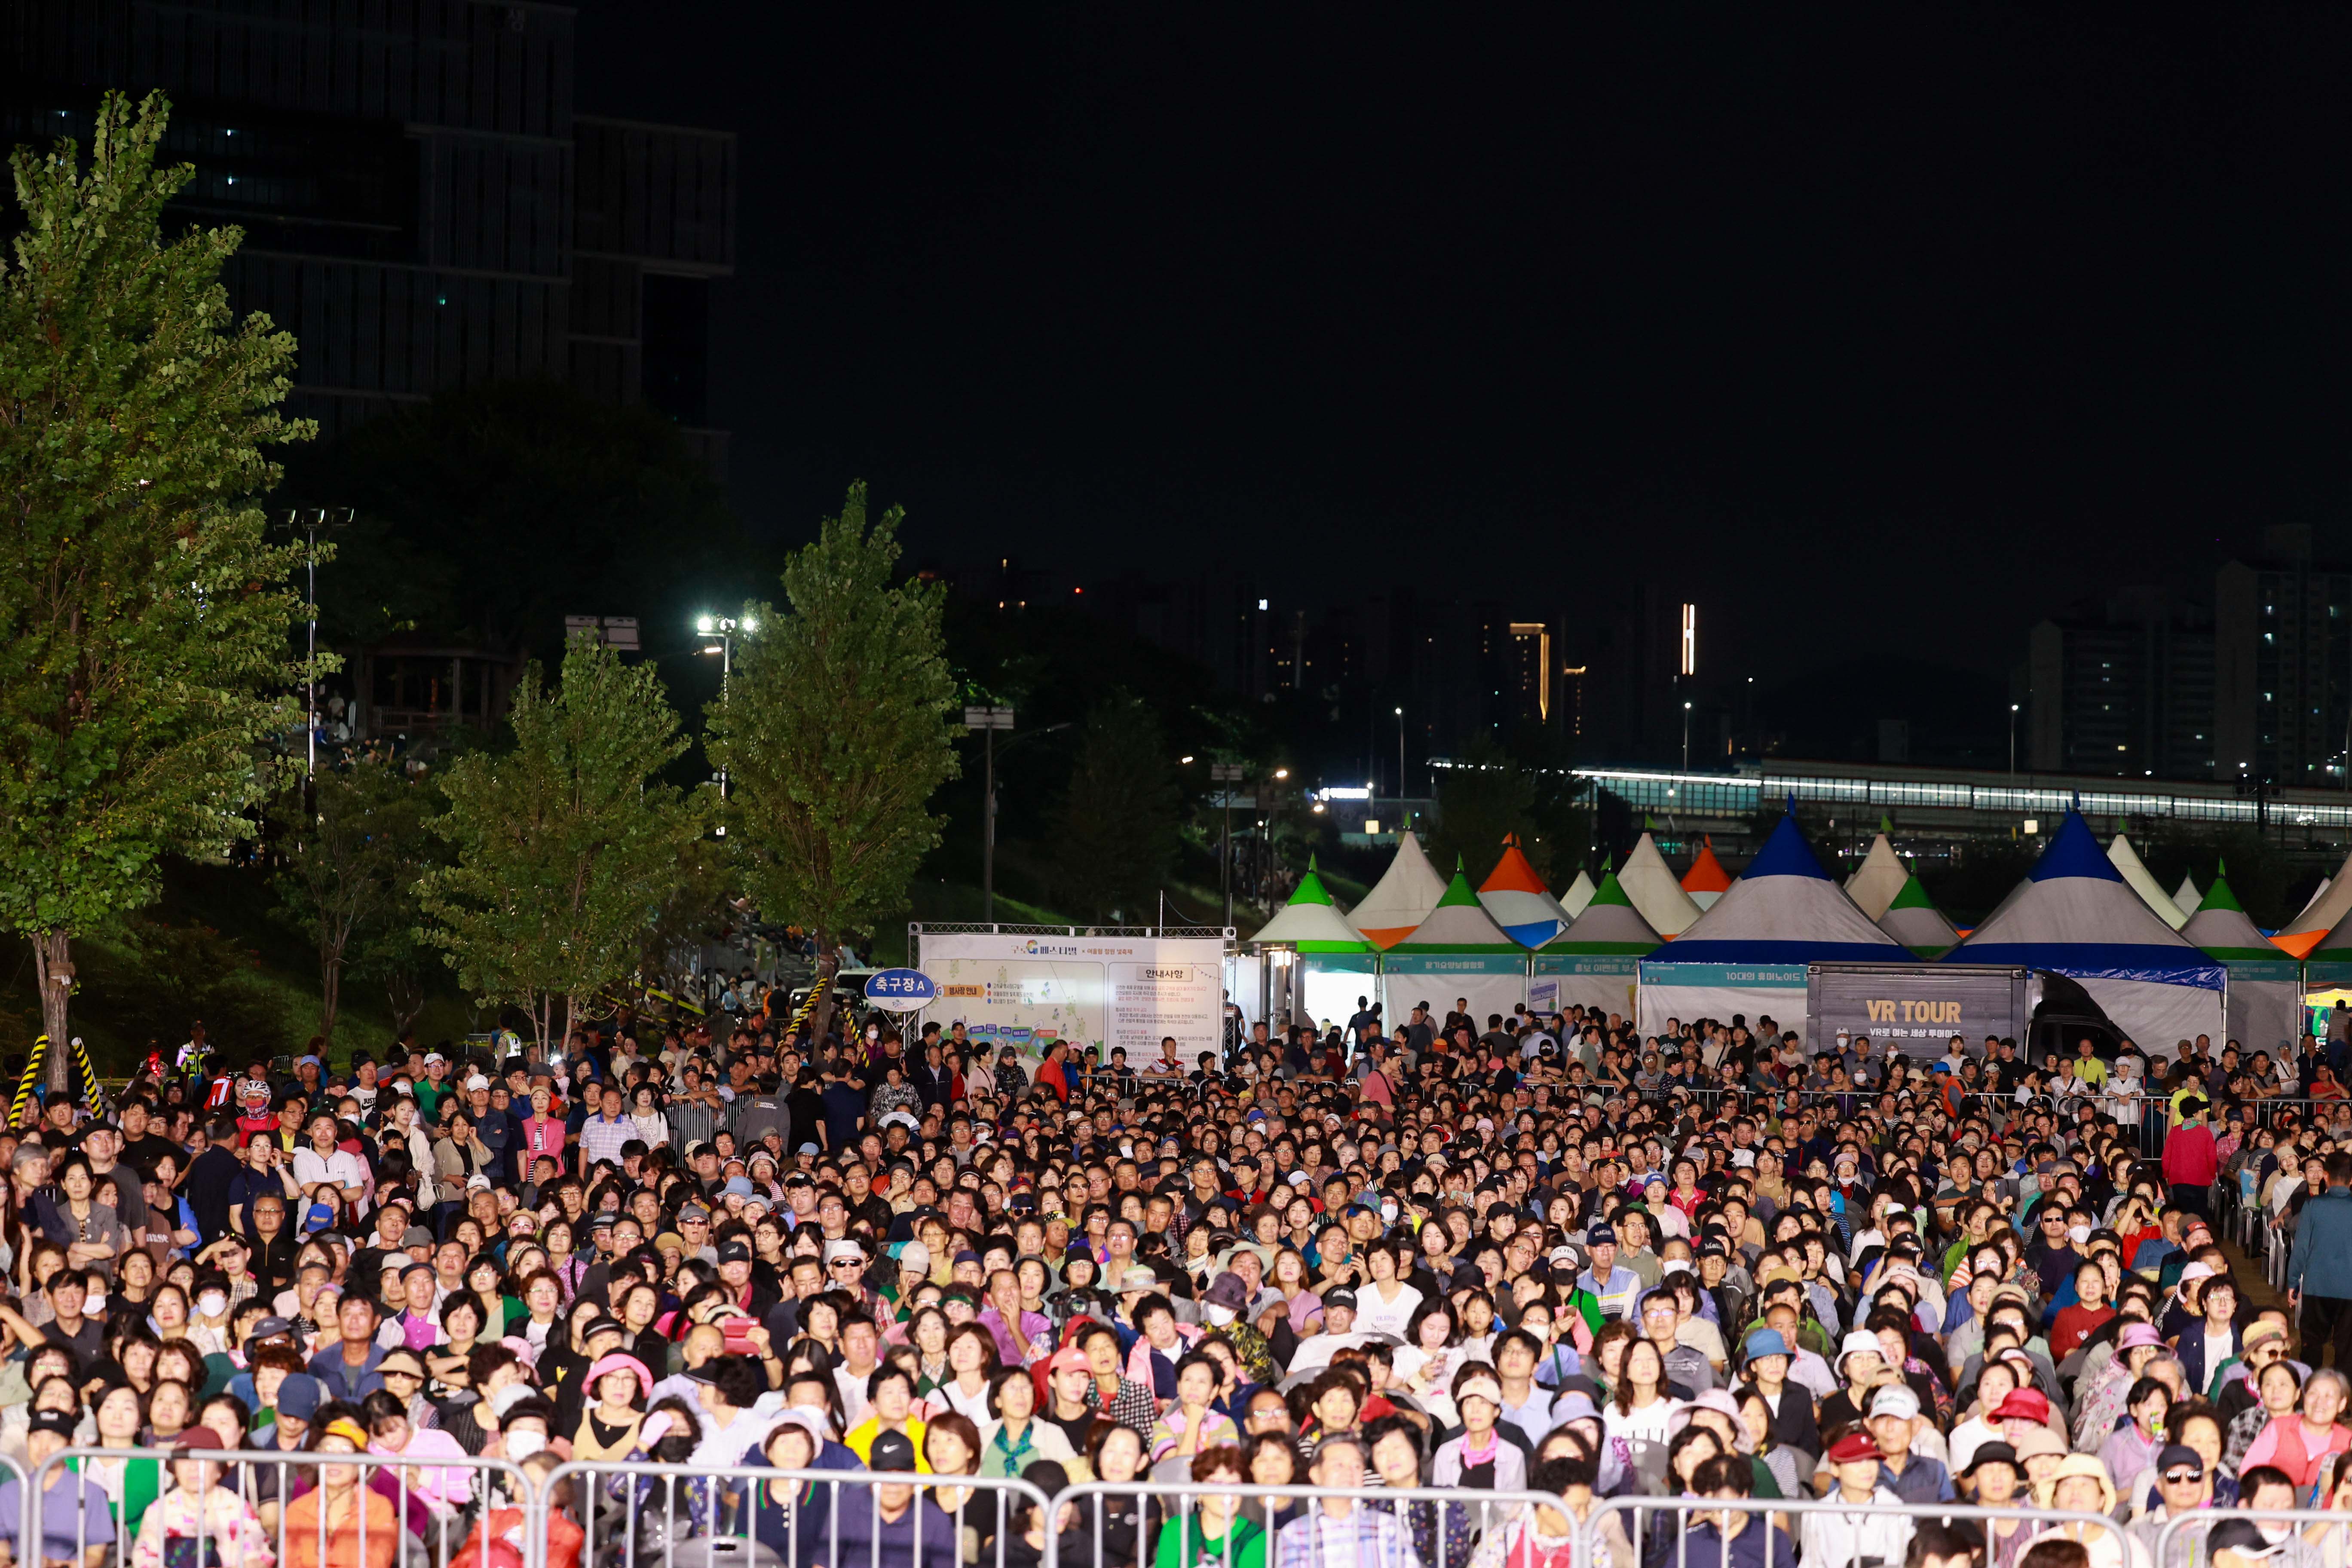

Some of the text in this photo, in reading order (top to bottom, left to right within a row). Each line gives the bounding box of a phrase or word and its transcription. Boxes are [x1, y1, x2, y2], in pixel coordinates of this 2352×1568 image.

[1040, 946, 1077, 956] 페스티벌
[1593, 964, 1619, 972] 이벤트
[1145, 969, 1183, 978] 안내사항
[1726, 972, 1755, 980] 10대의
[1758, 972, 1801, 981] 휴머노이드
[876, 977, 925, 992] 축구장 A
[966, 987, 977, 995] 안내
[1866, 1000, 1961, 1023] VR TOUR
[1870, 1028, 1890, 1037] VR로
[1892, 1028, 1908, 1037] 여는
[1910, 1029, 1927, 1038] 세상
